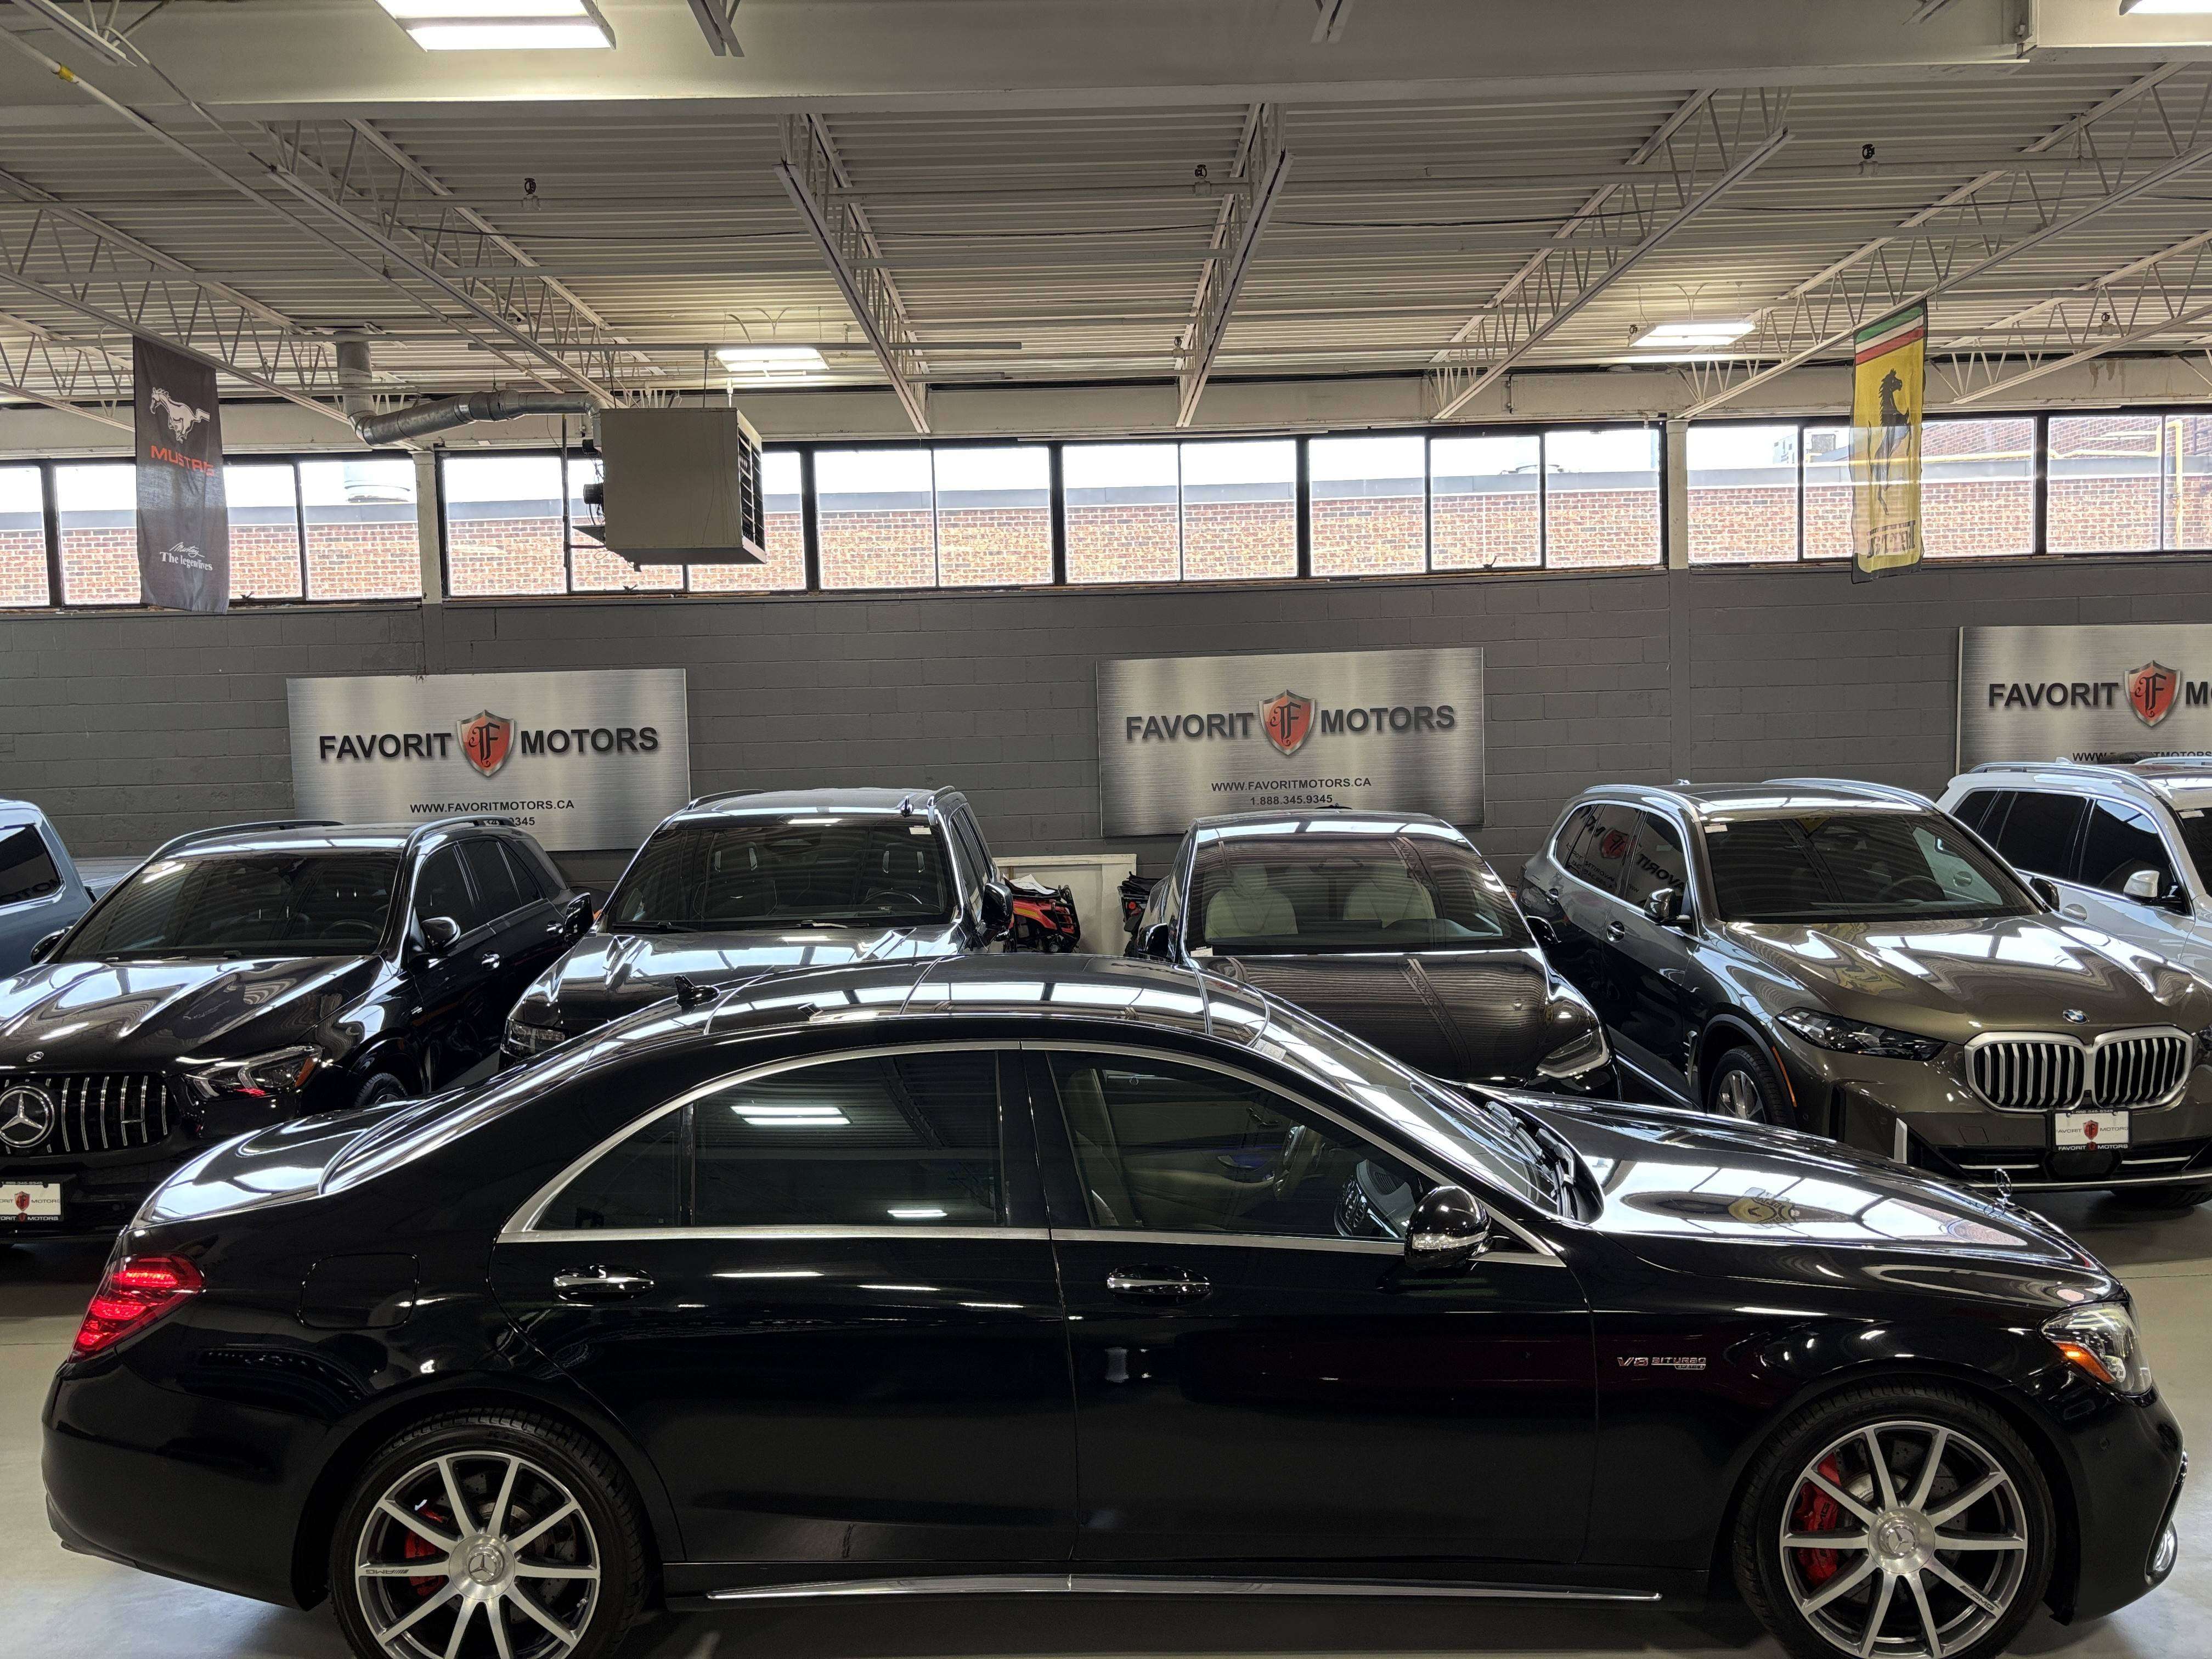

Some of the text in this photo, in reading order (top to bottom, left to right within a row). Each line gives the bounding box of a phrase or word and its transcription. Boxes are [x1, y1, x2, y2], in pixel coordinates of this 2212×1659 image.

[160, 551, 179, 563] The
[1989, 682, 2119, 707] FAVORIT
[2186, 681, 2212, 704] M
[1126, 713, 1254, 740] FAVORIT
[1321, 705, 1455, 733] MOTORS
[319, 733, 452, 759] FAVORIT
[521, 727, 658, 754] MOTORS
[1211, 778, 1372, 792] WWW.FAVORITMOTORS.CA
[410, 799, 574, 813] WWW.FAVORITMOTORS.CA
[1250, 794, 1334, 805] 1.888.345.9345
[1617, 1357, 1649, 1367] V8
